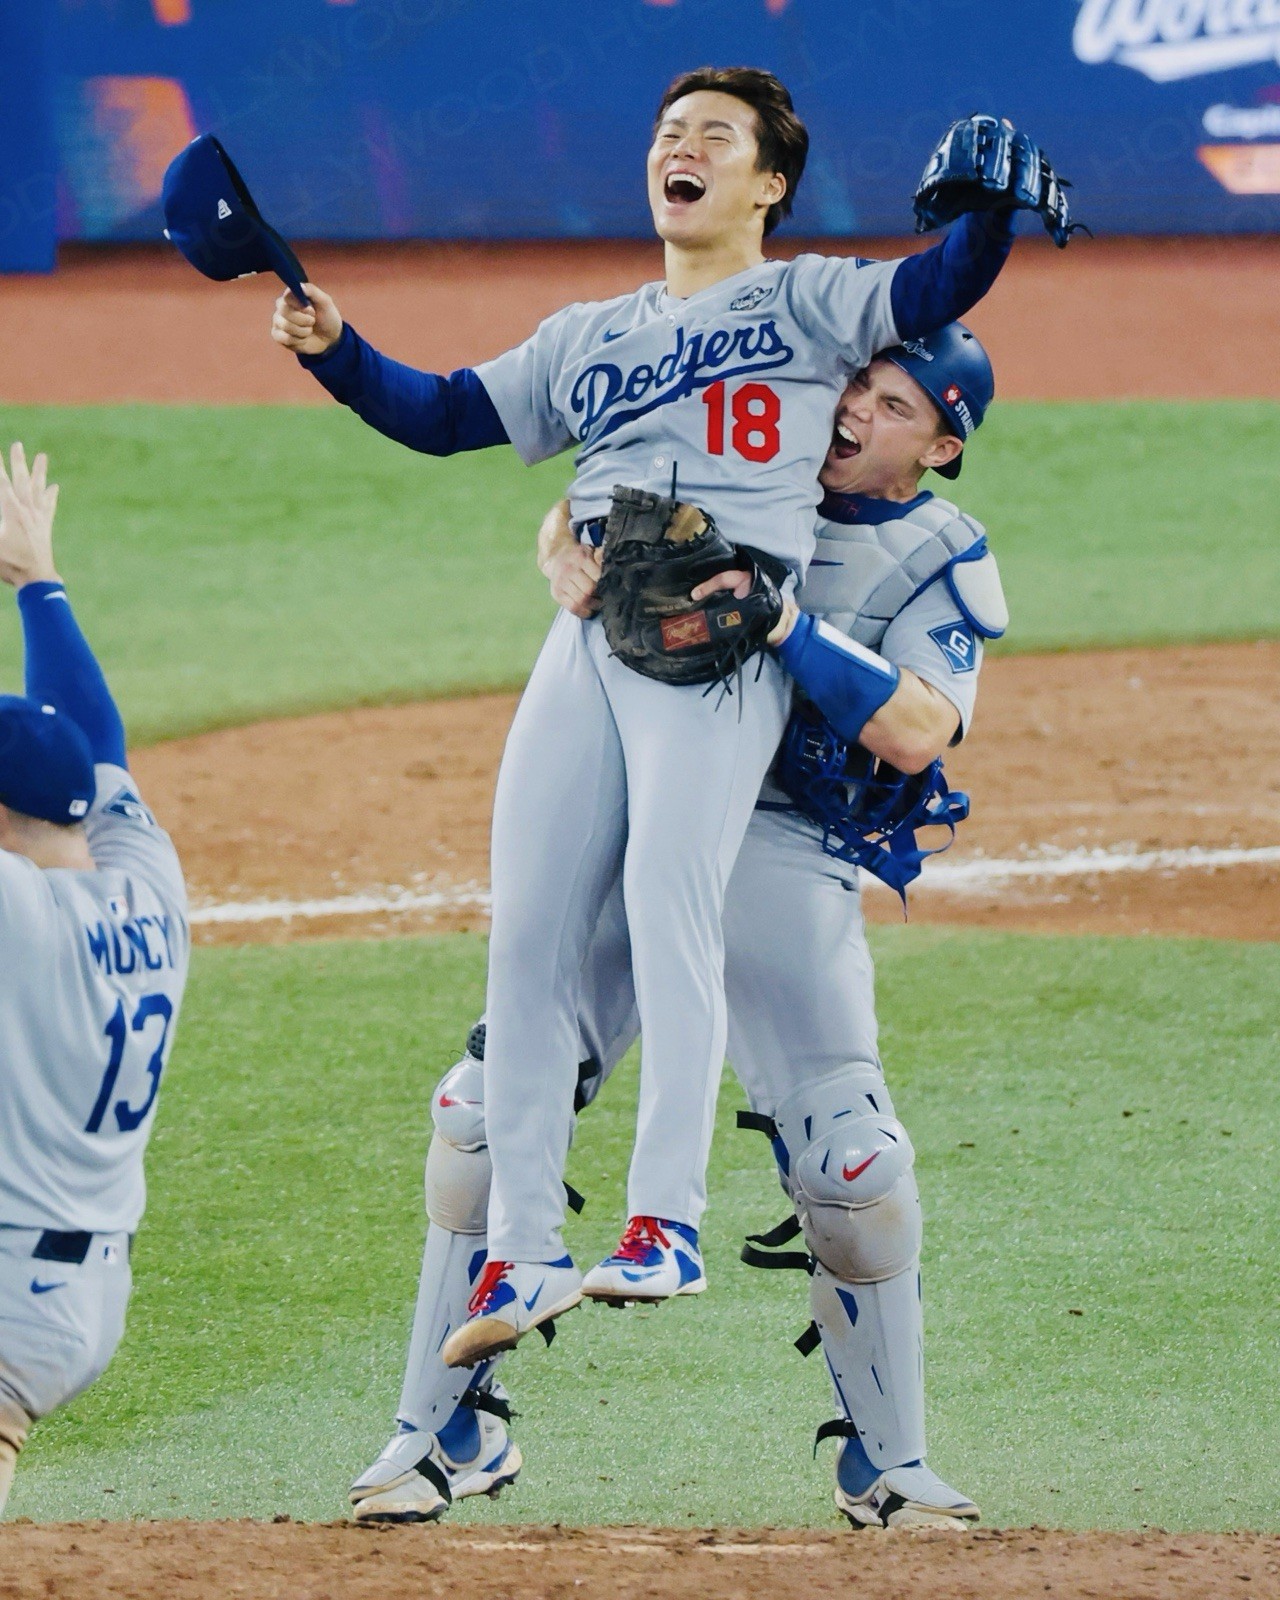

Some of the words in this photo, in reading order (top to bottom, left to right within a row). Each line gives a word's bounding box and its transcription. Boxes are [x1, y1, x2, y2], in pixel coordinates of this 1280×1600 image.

[571, 320, 794, 446] Dodgers
[702, 381, 781, 464] 18
[84, 993, 173, 1133] 13
